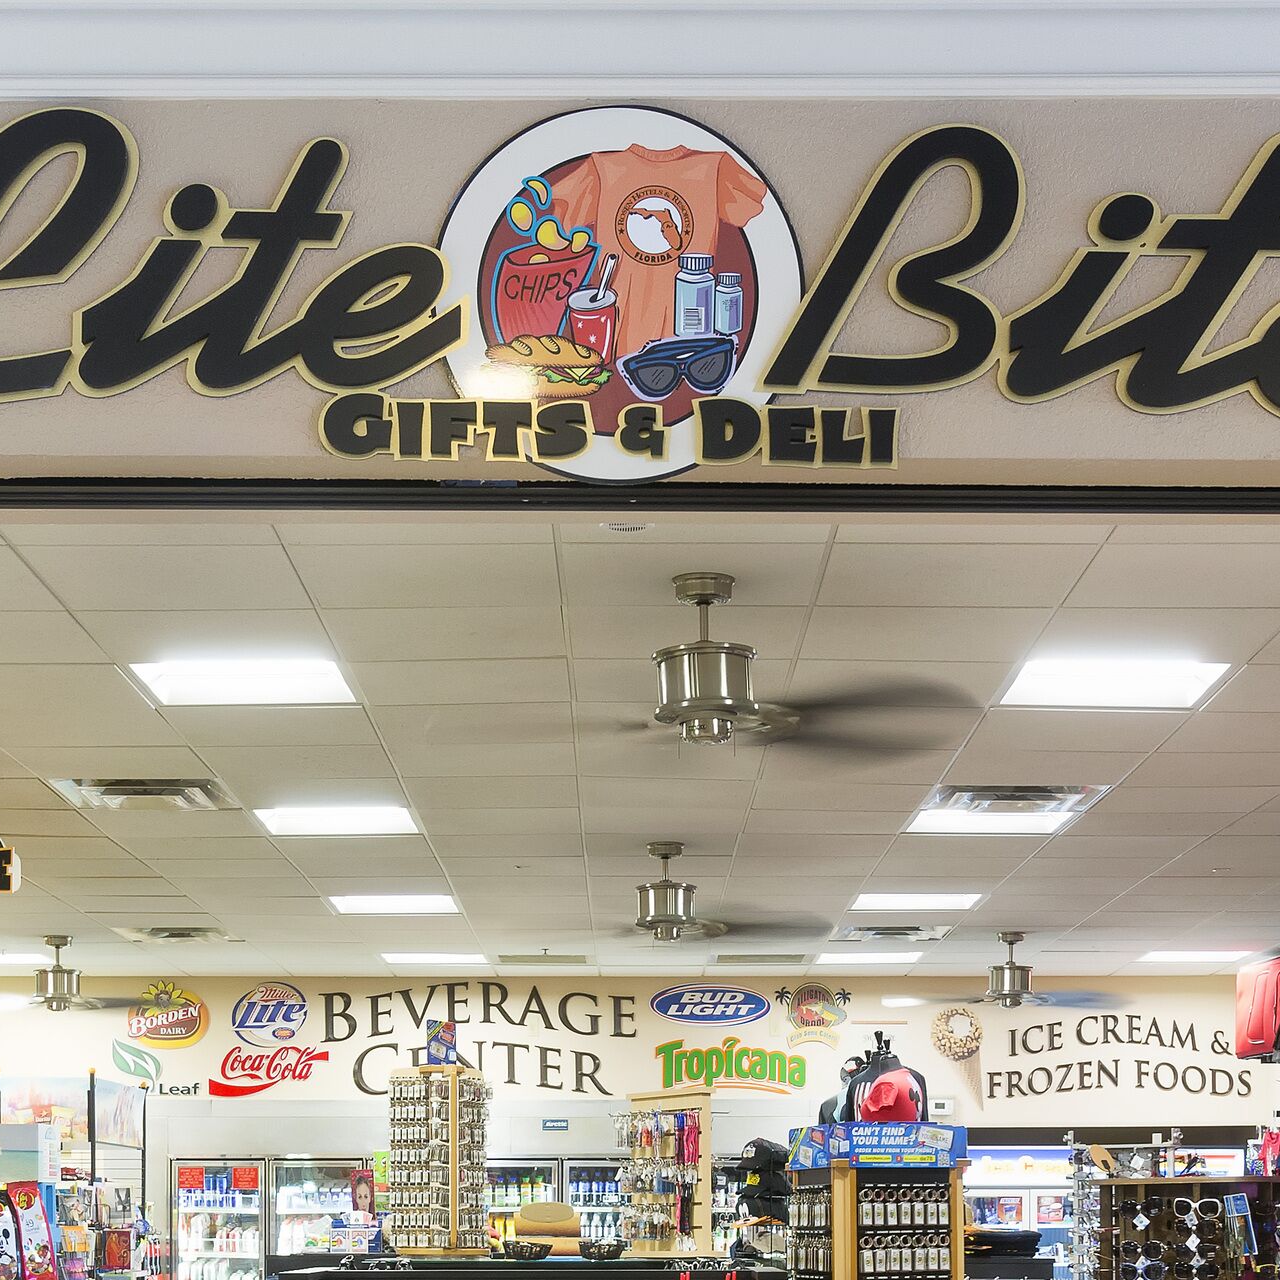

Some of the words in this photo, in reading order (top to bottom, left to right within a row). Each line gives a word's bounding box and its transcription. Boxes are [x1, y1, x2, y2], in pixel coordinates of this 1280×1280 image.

[634, 252, 672, 263] FLORIDA
[503, 267, 577, 304] CHIPS
[321, 392, 592, 462] GIFTS
[617, 404, 669, 462] &
[694, 398, 900, 470] DELI
[257, 986, 298, 1001] Miller
[680, 992, 745, 1004] BUD
[128, 1003, 202, 1038] BORDEN
[233, 999, 306, 1031] Lite
[318, 981, 638, 1043] BEVERAGE
[667, 1004, 756, 1016] LIGHT
[160, 1026, 188, 1036] DAIRY
[1008, 1021, 1064, 1057] ICE
[1076, 1014, 1200, 1051] CREAM
[1210, 1030, 1233, 1056] &
[220, 1046, 318, 1081] Coca-Cola
[655, 1037, 808, 1089] Tropicana
[987, 1059, 1120, 1098] FROZEN
[1134, 1059, 1252, 1097] FOODS
[159, 1082, 200, 1096] Leaf
[852, 1127, 880, 1136] CAN'T
[882, 1127, 905, 1136] FIND
[852, 1136, 879, 1146] YOUR
[881, 1135, 916, 1146] NAME?
